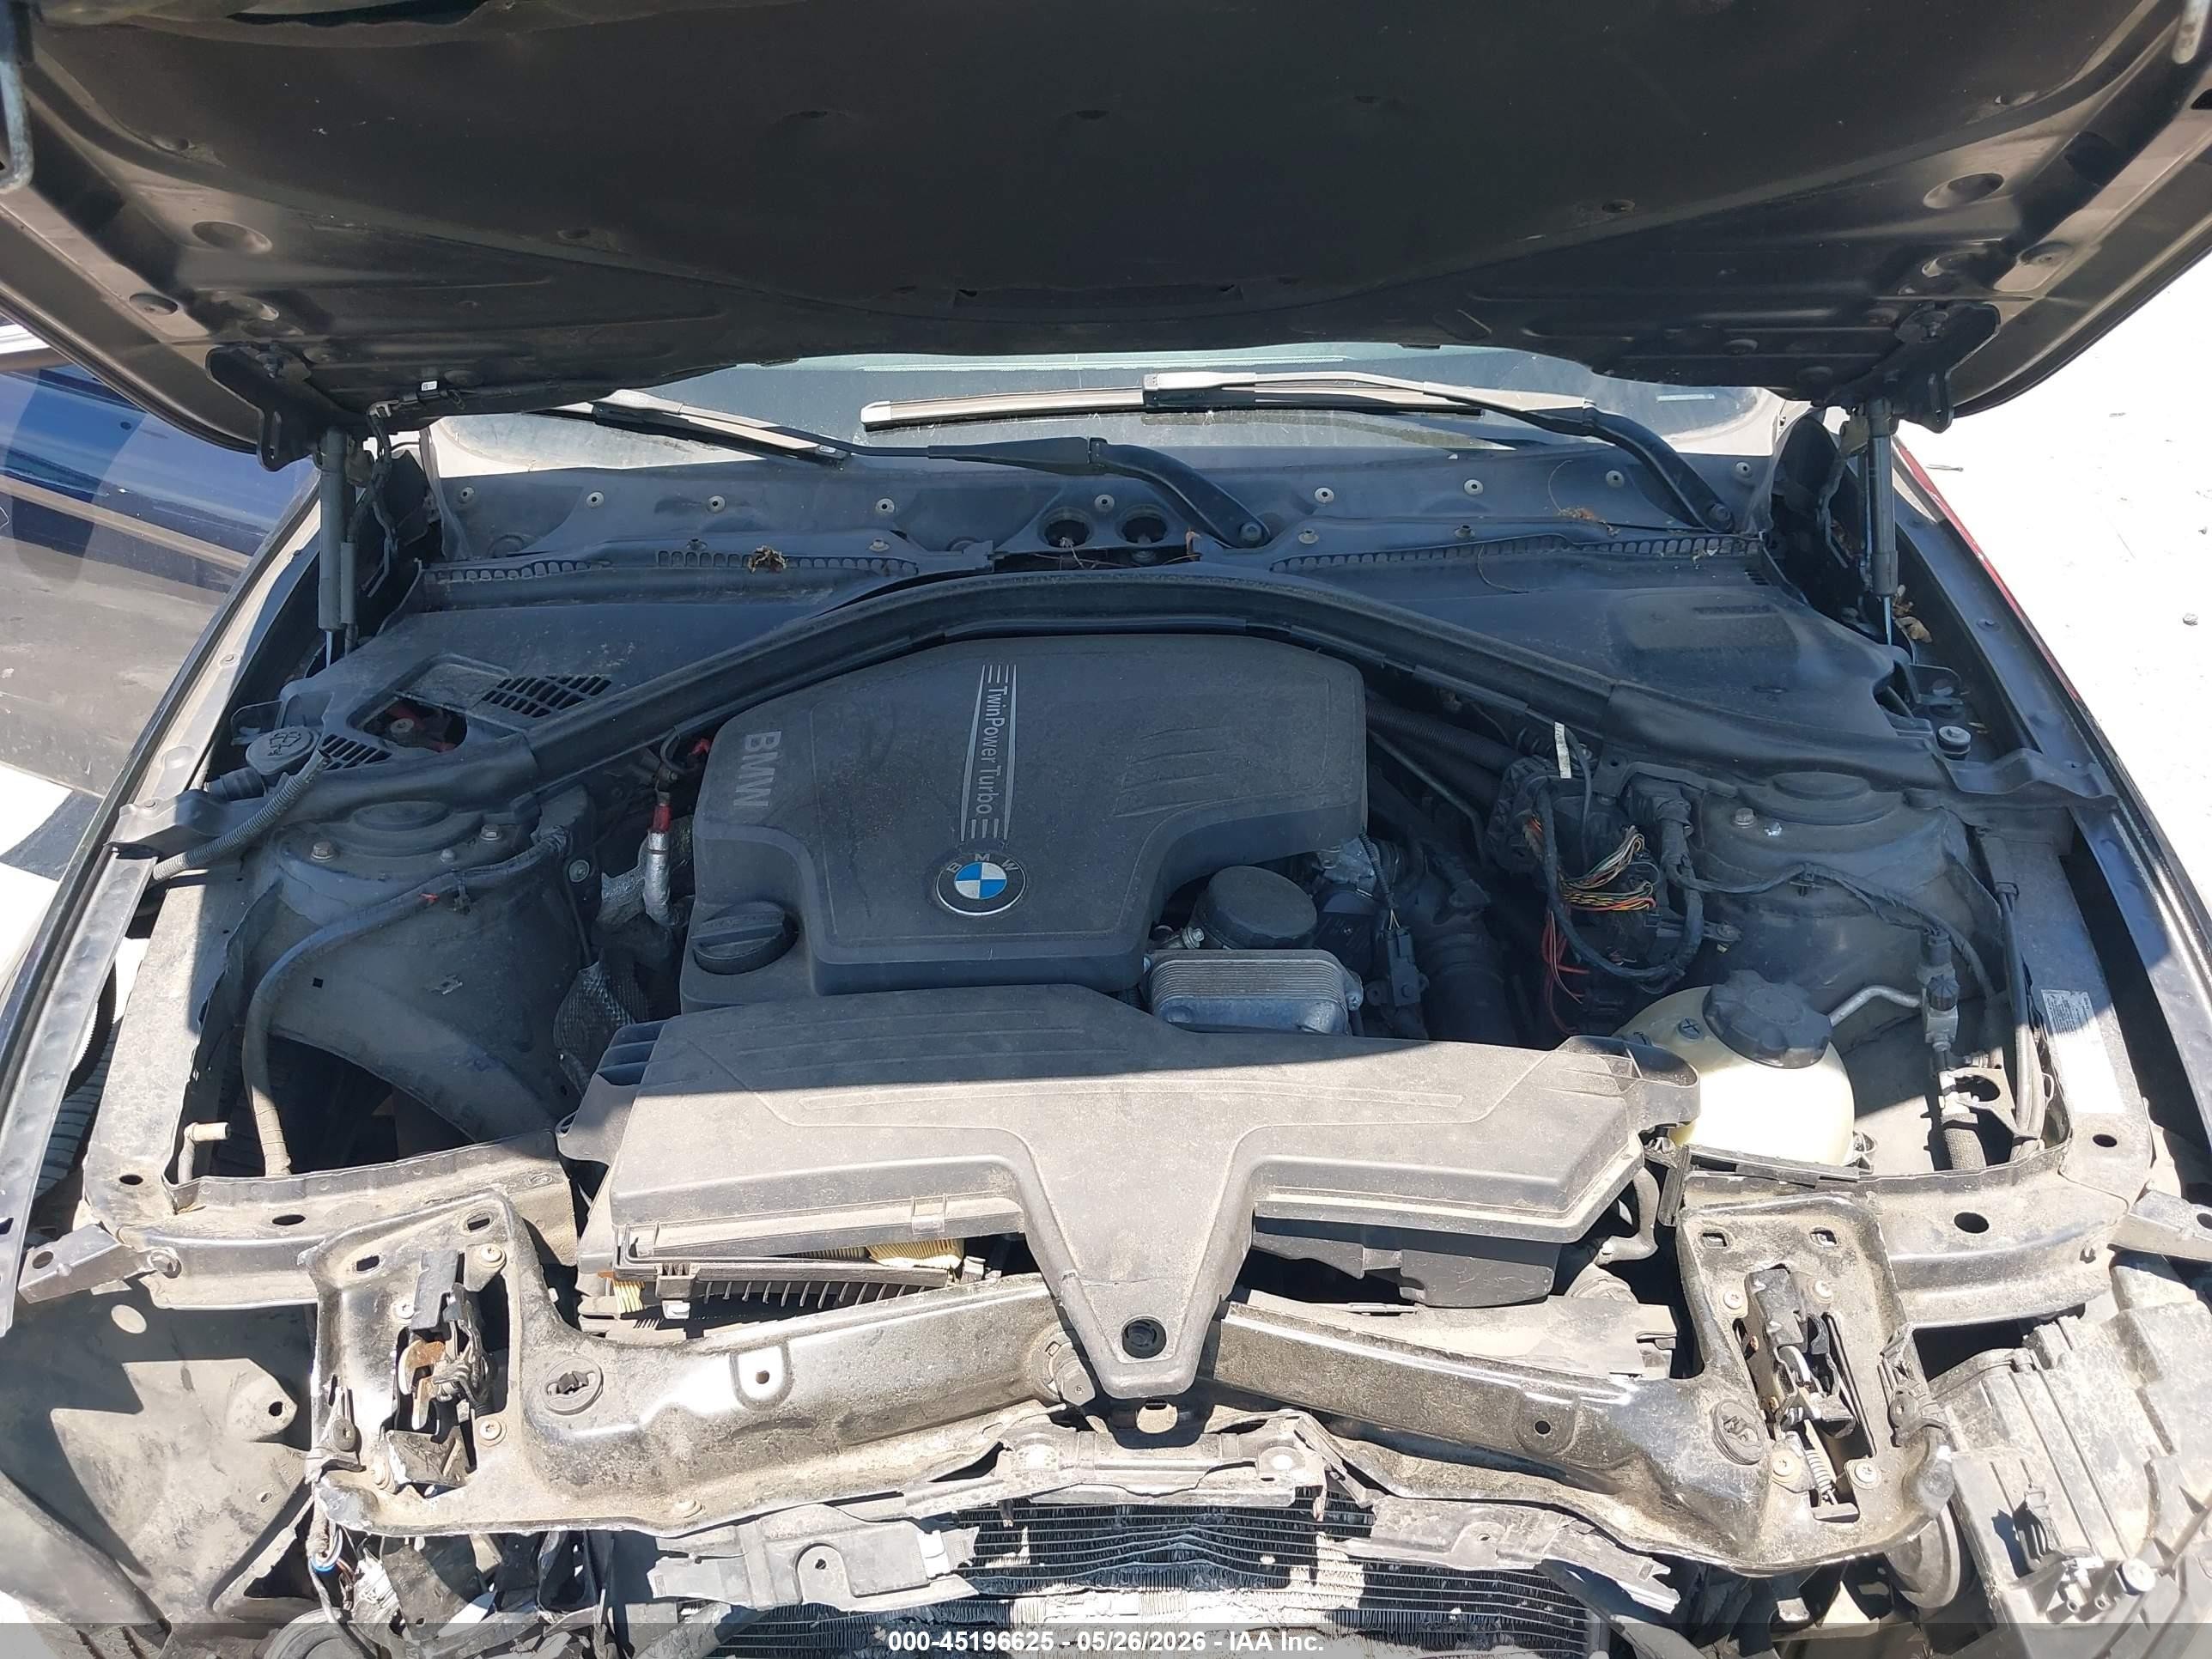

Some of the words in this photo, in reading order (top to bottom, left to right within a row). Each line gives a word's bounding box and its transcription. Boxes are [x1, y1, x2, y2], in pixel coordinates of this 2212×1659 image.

[981, 685, 1008, 763] TwinPower
[733, 731, 782, 806] BMW
[975, 765, 1002, 815] Turbo
[946, 853, 1019, 873] BMW
